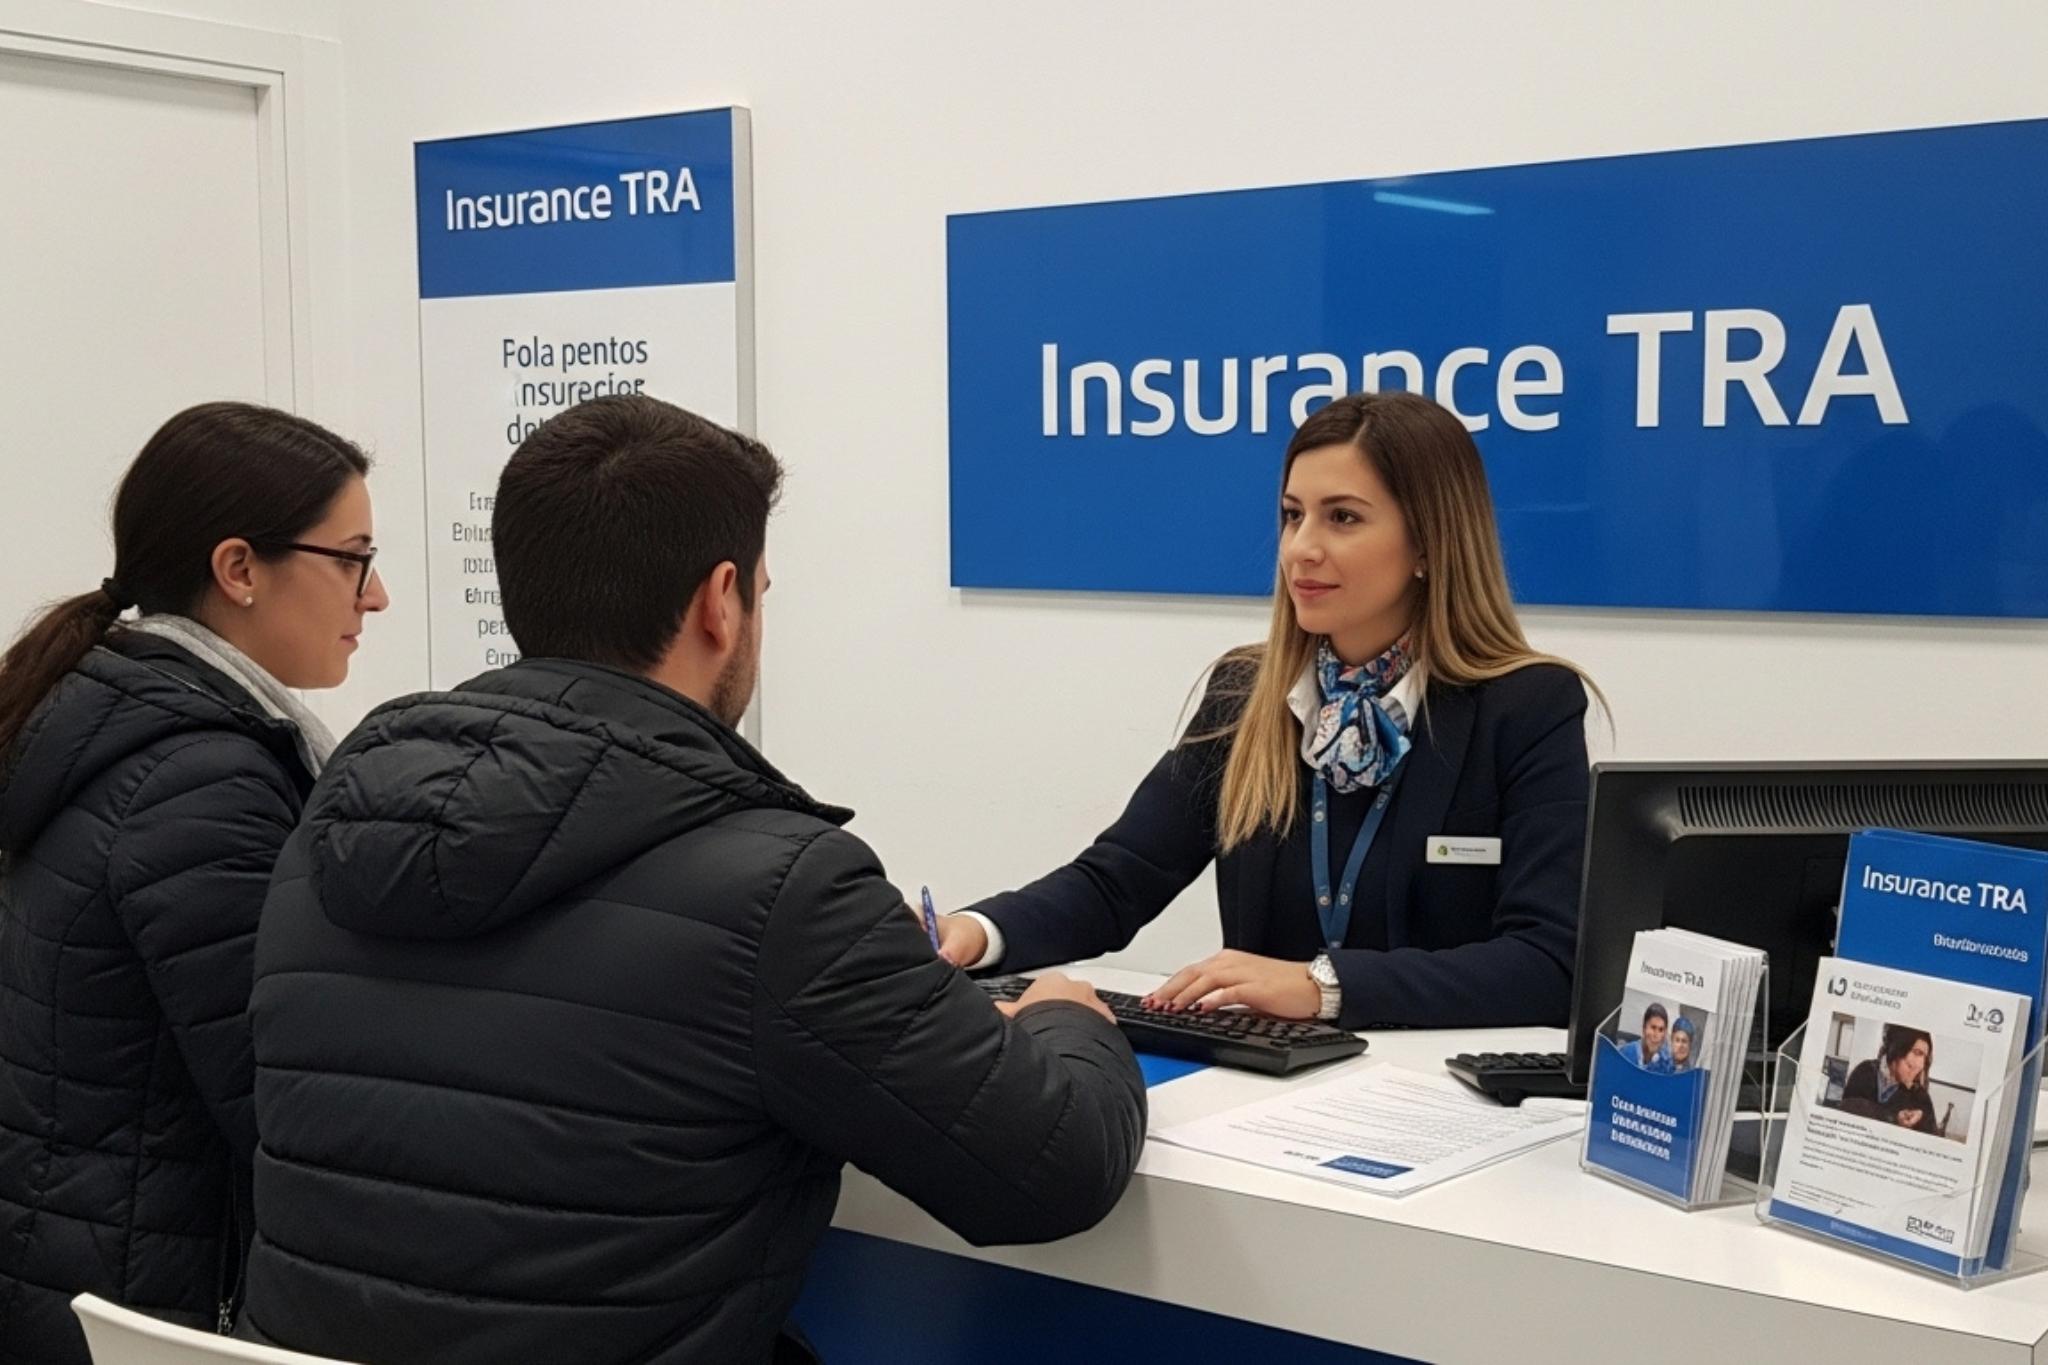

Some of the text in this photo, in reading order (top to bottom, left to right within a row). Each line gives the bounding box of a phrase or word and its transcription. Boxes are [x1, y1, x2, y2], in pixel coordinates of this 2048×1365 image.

[446, 166, 701, 231] Insurance TRA
[502, 335, 649, 373] Fola pentos
[1041, 303, 1911, 437] Insurance TRA
[1862, 864, 2028, 914] Insurance TRA
